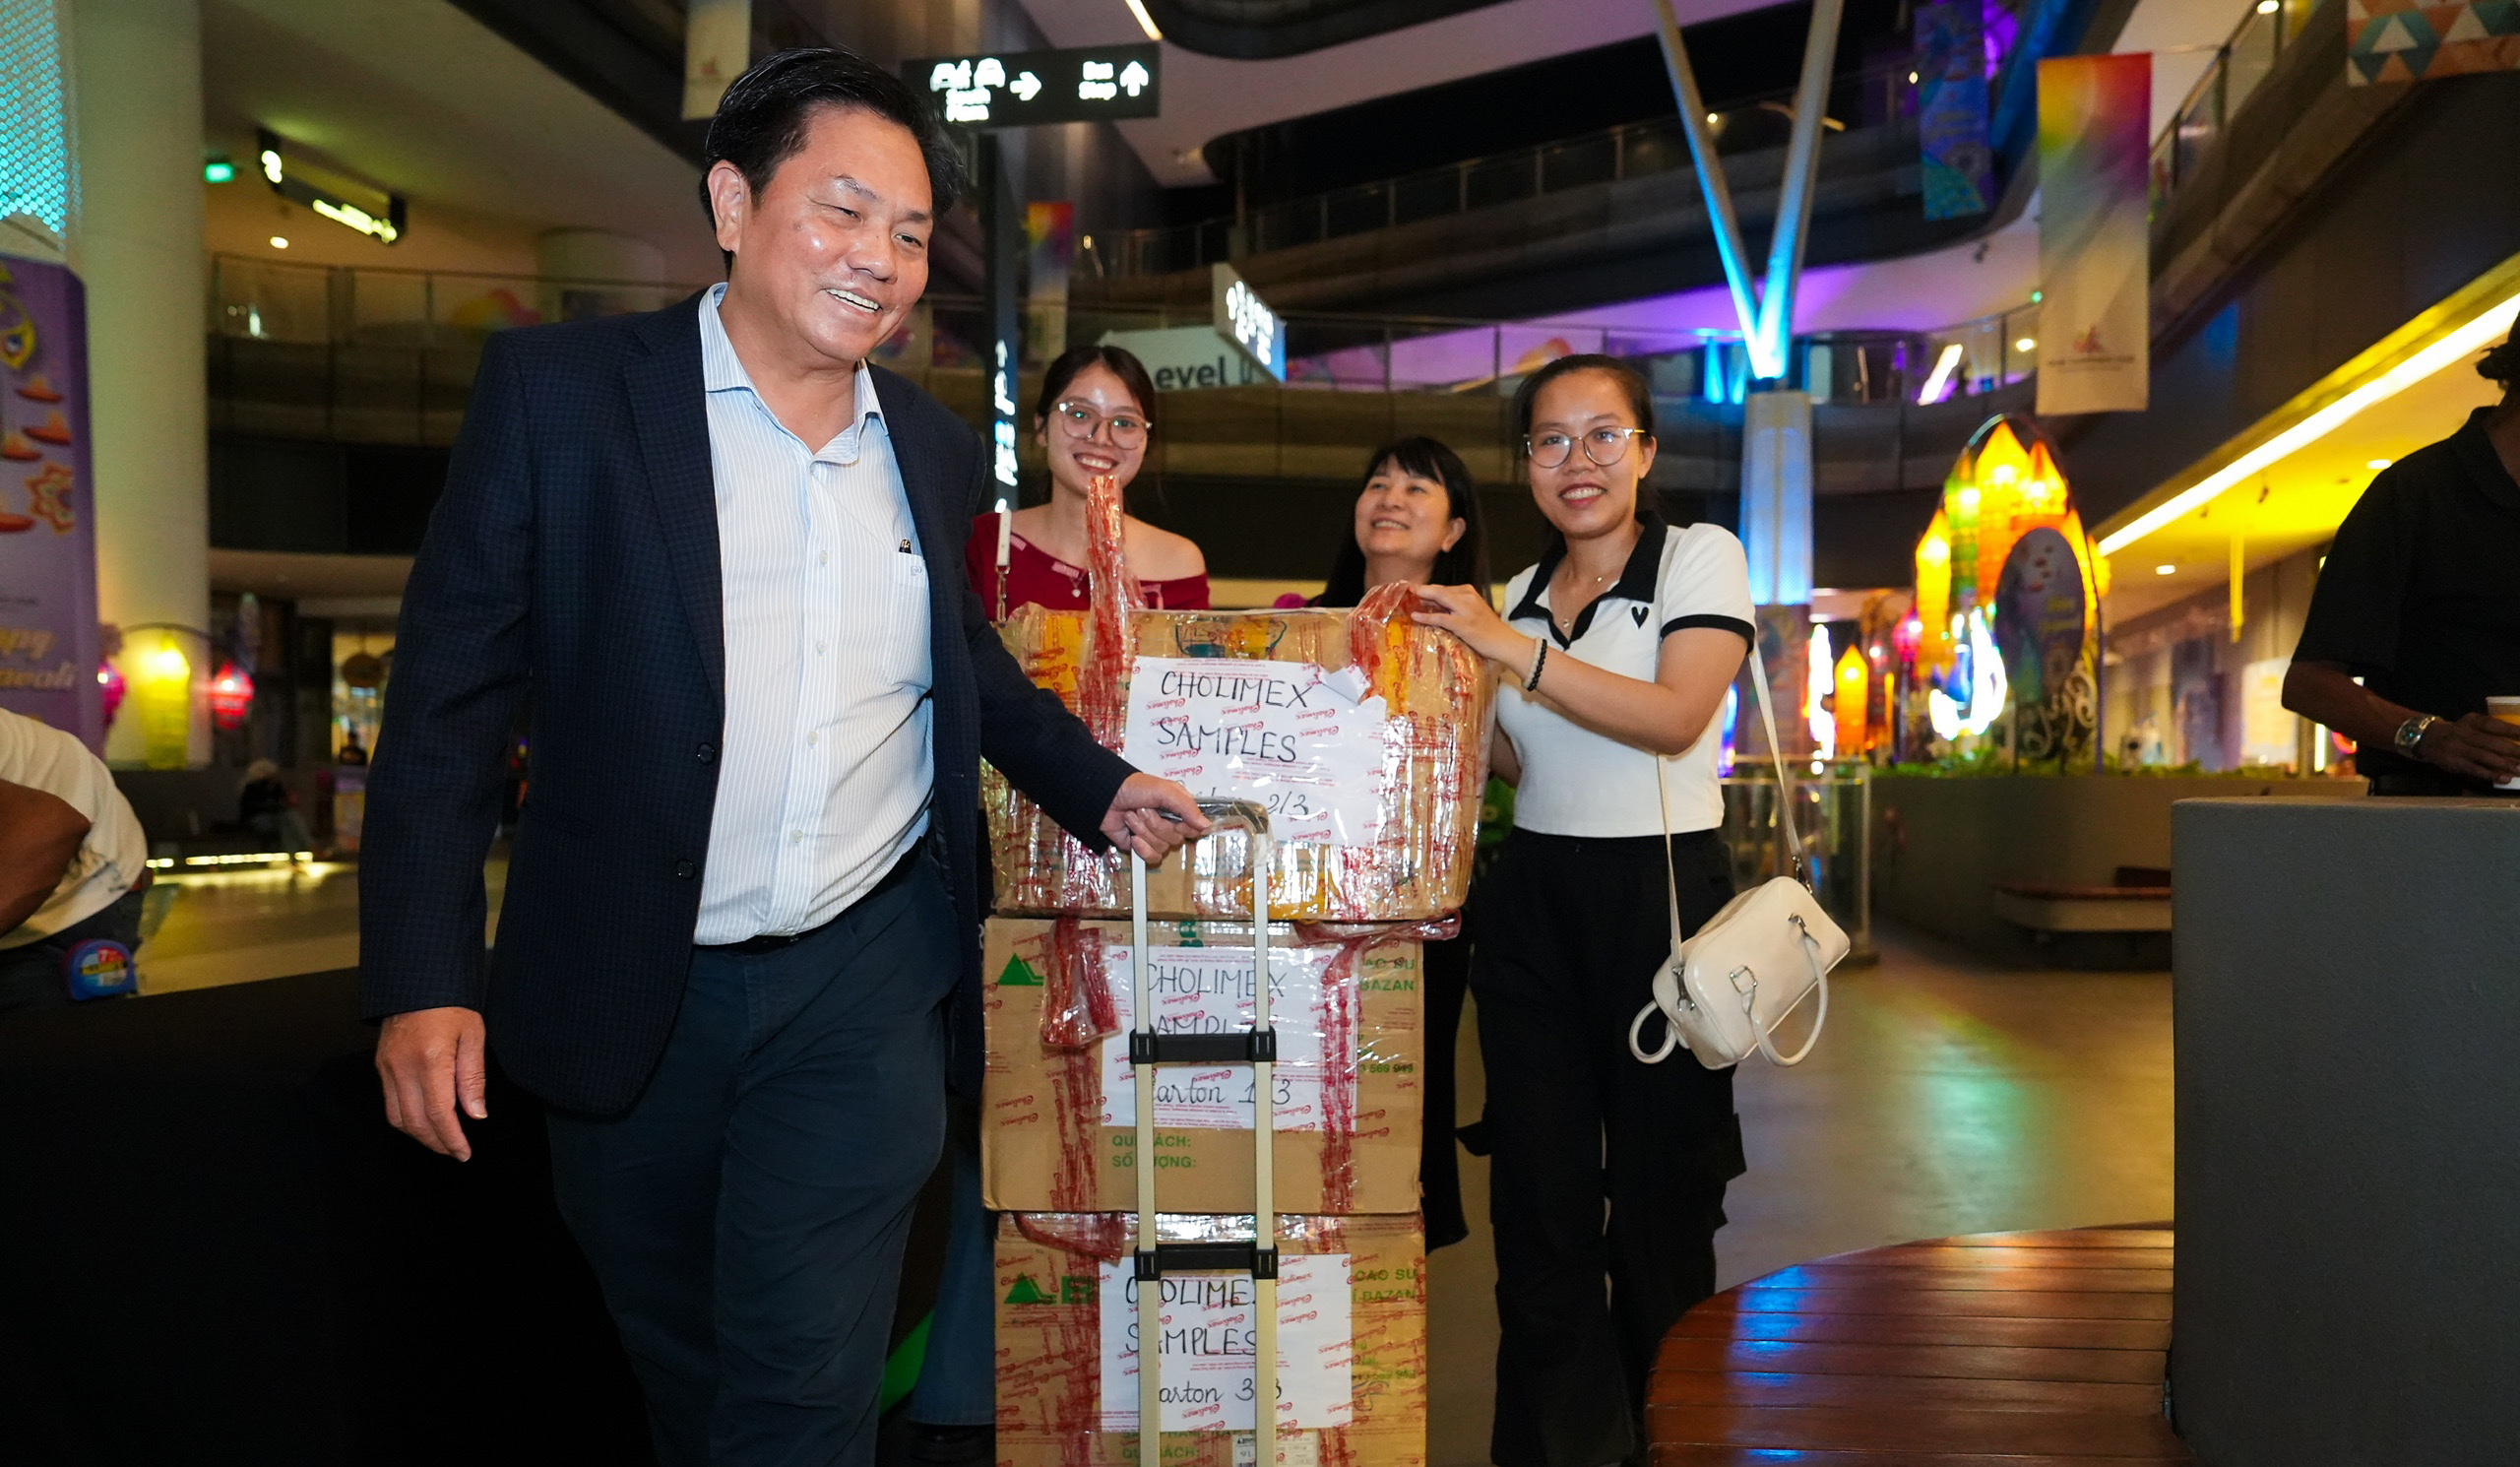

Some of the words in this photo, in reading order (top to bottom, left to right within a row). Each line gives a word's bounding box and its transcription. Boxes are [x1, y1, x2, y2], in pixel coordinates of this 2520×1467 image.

[1155, 354, 1227, 390] evel
[1161, 670, 1313, 708] CHOLIMEX
[1146, 697, 1186, 710] Cholimex
[1221, 702, 1261, 715] Cholimex
[1295, 708, 1336, 721] Cholimex
[1157, 716, 1296, 763] SAMPLES
[1299, 726, 1340, 738] Cholimex
[1164, 765, 1203, 779] Cholimex
[1267, 791, 1310, 816] 2/3
[1291, 829, 1332, 842] Cholimex
[1359, 979, 1416, 992] BAZAN
[1162, 991, 1201, 1006] Cholimex
[1193, 1069, 1232, 1083] Cholimex
[1153, 1077, 1227, 1105] arton
[1273, 1104, 1312, 1117] Cholimex
[1395, 1268, 1418, 1281] SU
[1206, 1313, 1245, 1329] Cholimex
[1281, 1310, 1318, 1325] Cholimex
[1125, 1322, 1256, 1355] SMPLES
[1160, 1380, 1225, 1404] arton
[1182, 1403, 1221, 1419] Cholimex
